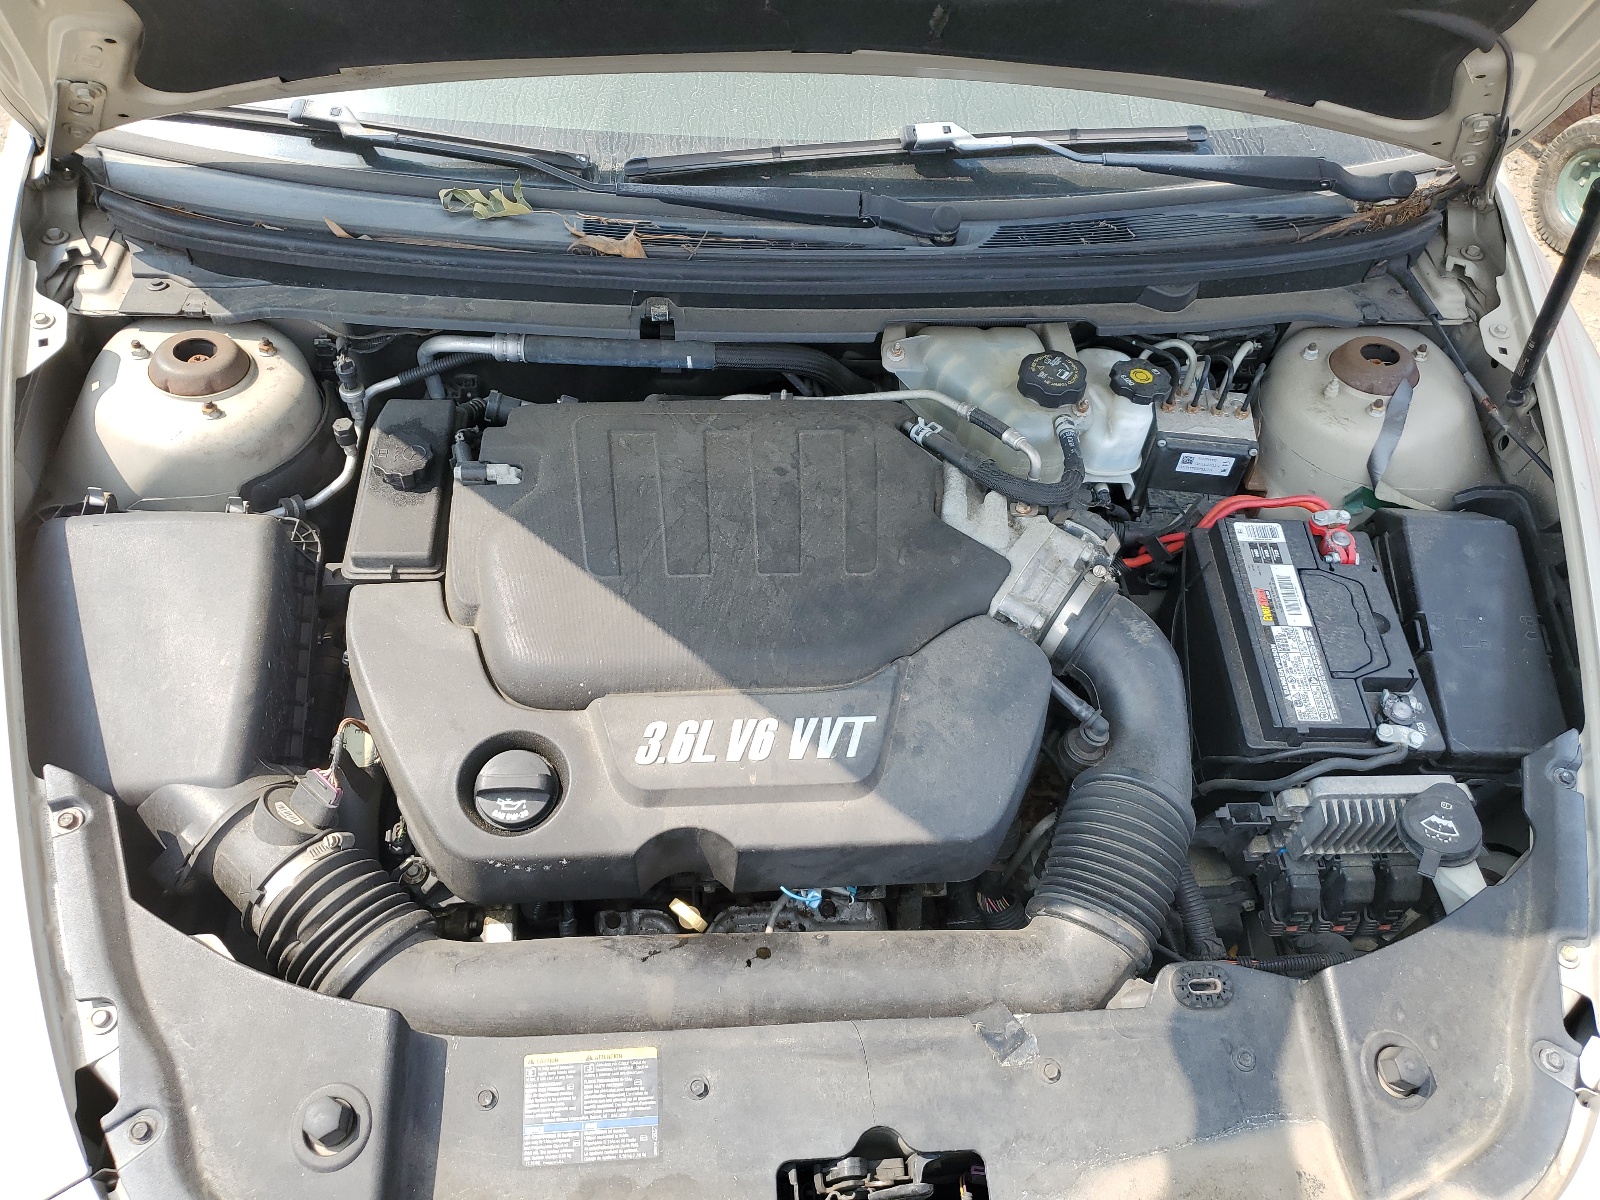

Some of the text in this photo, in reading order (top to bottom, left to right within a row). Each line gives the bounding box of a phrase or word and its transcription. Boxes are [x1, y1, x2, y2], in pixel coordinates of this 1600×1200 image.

[634, 715, 878, 765] 3.6L V6 VVT
